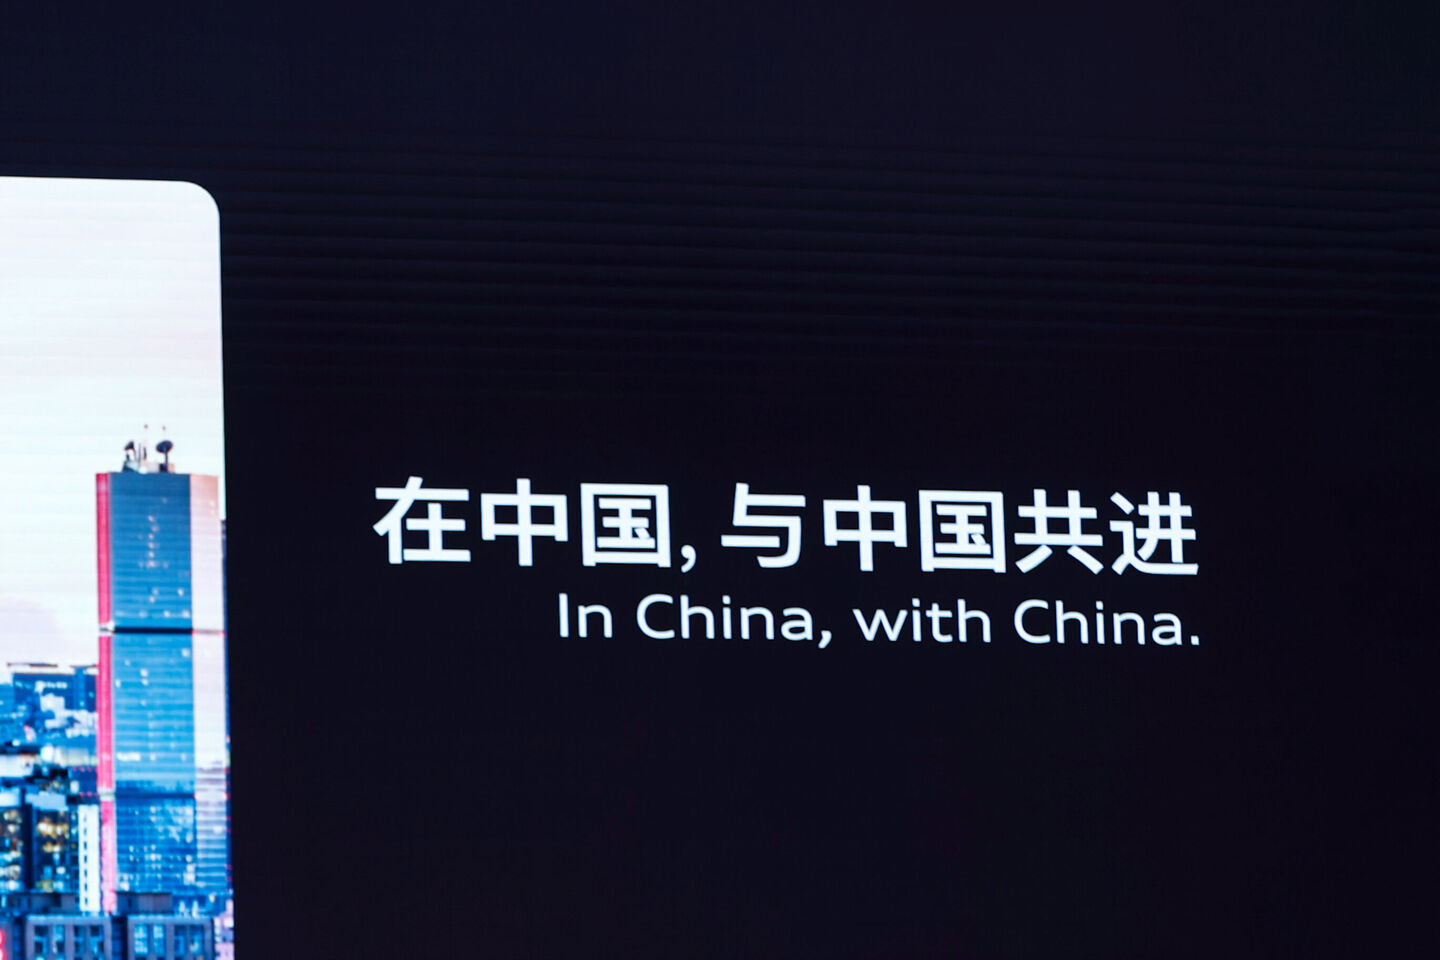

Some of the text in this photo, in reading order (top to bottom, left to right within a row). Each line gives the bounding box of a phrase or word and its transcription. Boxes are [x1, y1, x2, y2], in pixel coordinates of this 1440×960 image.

[558, 592, 1199, 648] In China, with China.
